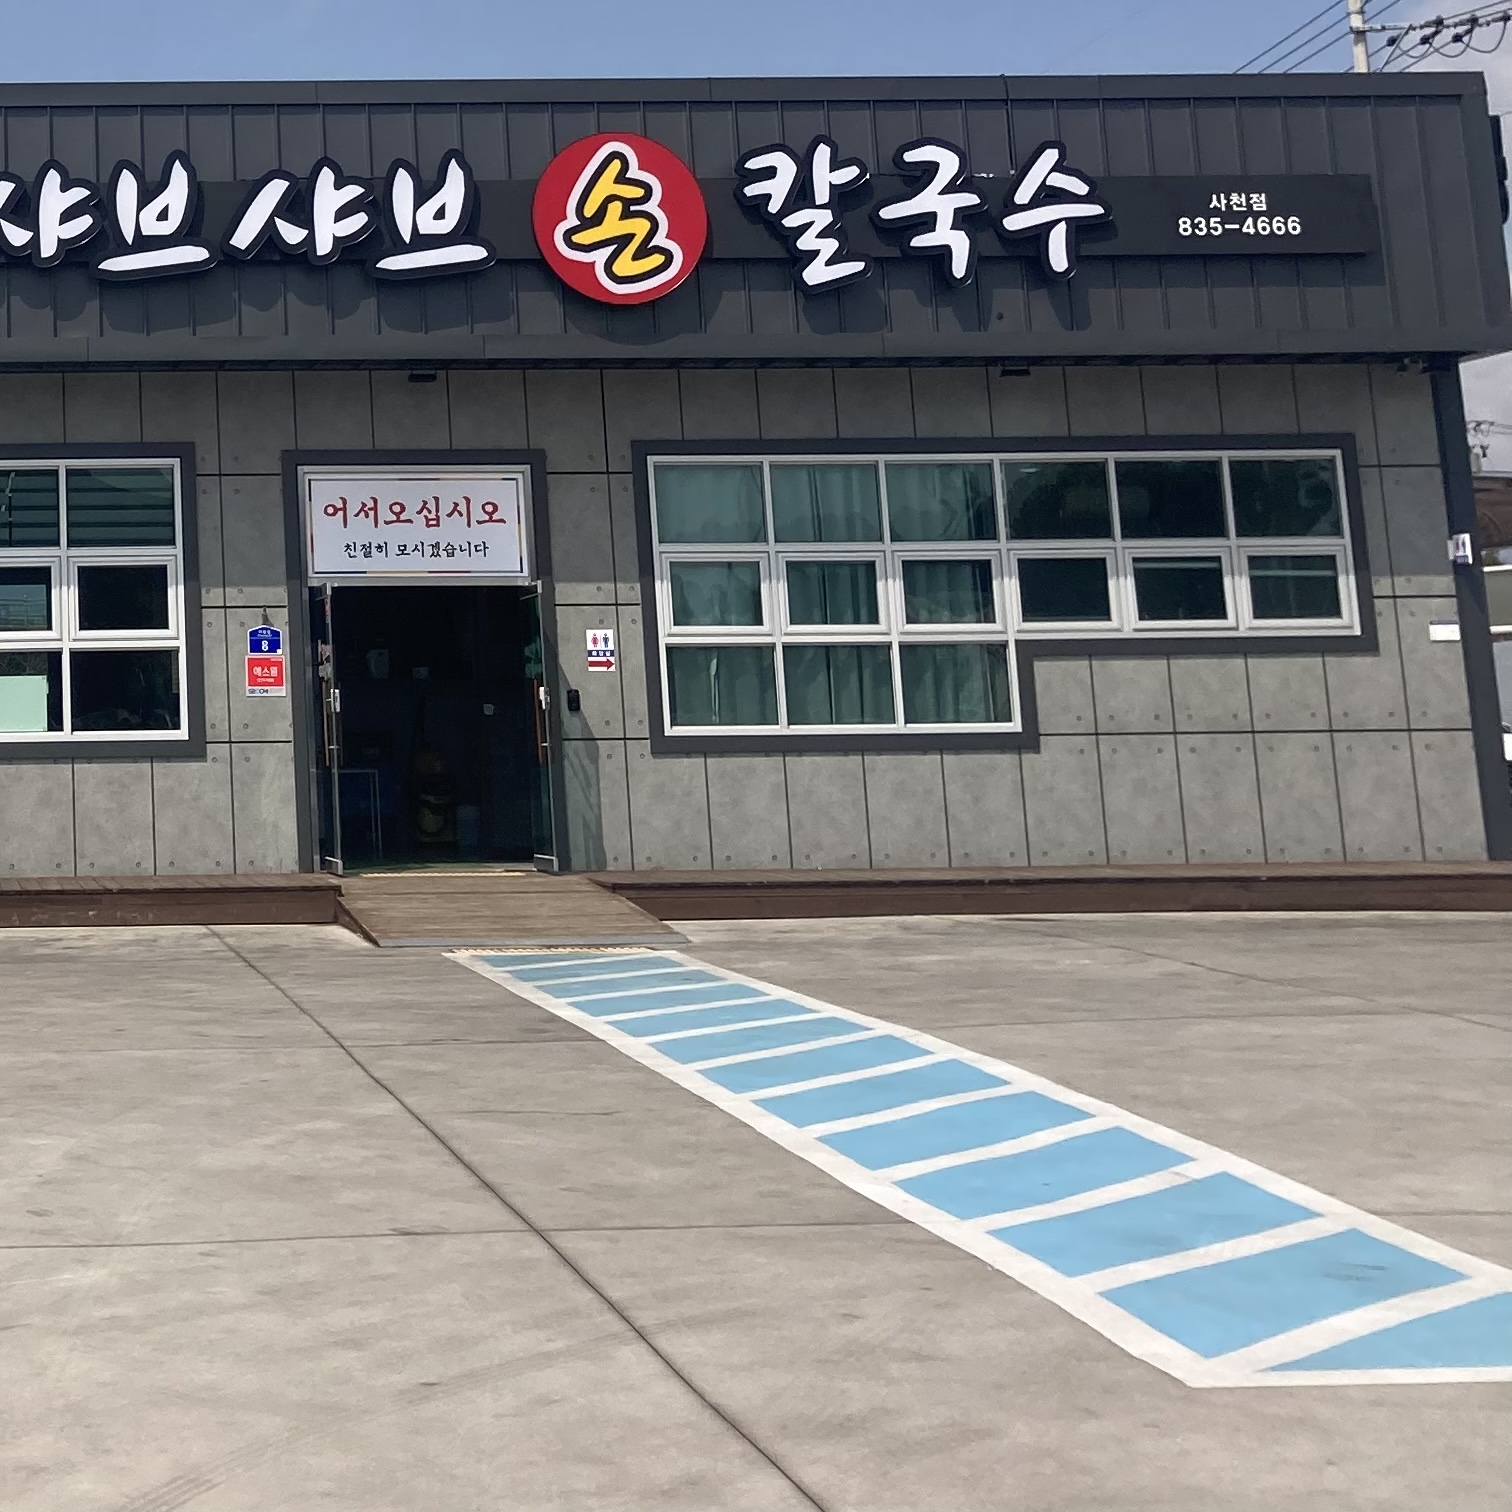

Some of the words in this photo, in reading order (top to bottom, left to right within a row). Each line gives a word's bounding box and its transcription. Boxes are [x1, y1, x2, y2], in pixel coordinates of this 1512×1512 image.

[1209, 192, 1267, 211] 사천점
[562, 150, 676, 285] 손
[743, 143, 1106, 287] 칼국수
[1178, 216, 1302, 236] 835-4666
[323, 495, 507, 529] 어서오십시오
[343, 541, 389, 558] 친절히
[395, 541, 490, 558] 모시겠습니다
[261, 640, 269, 651] 8
